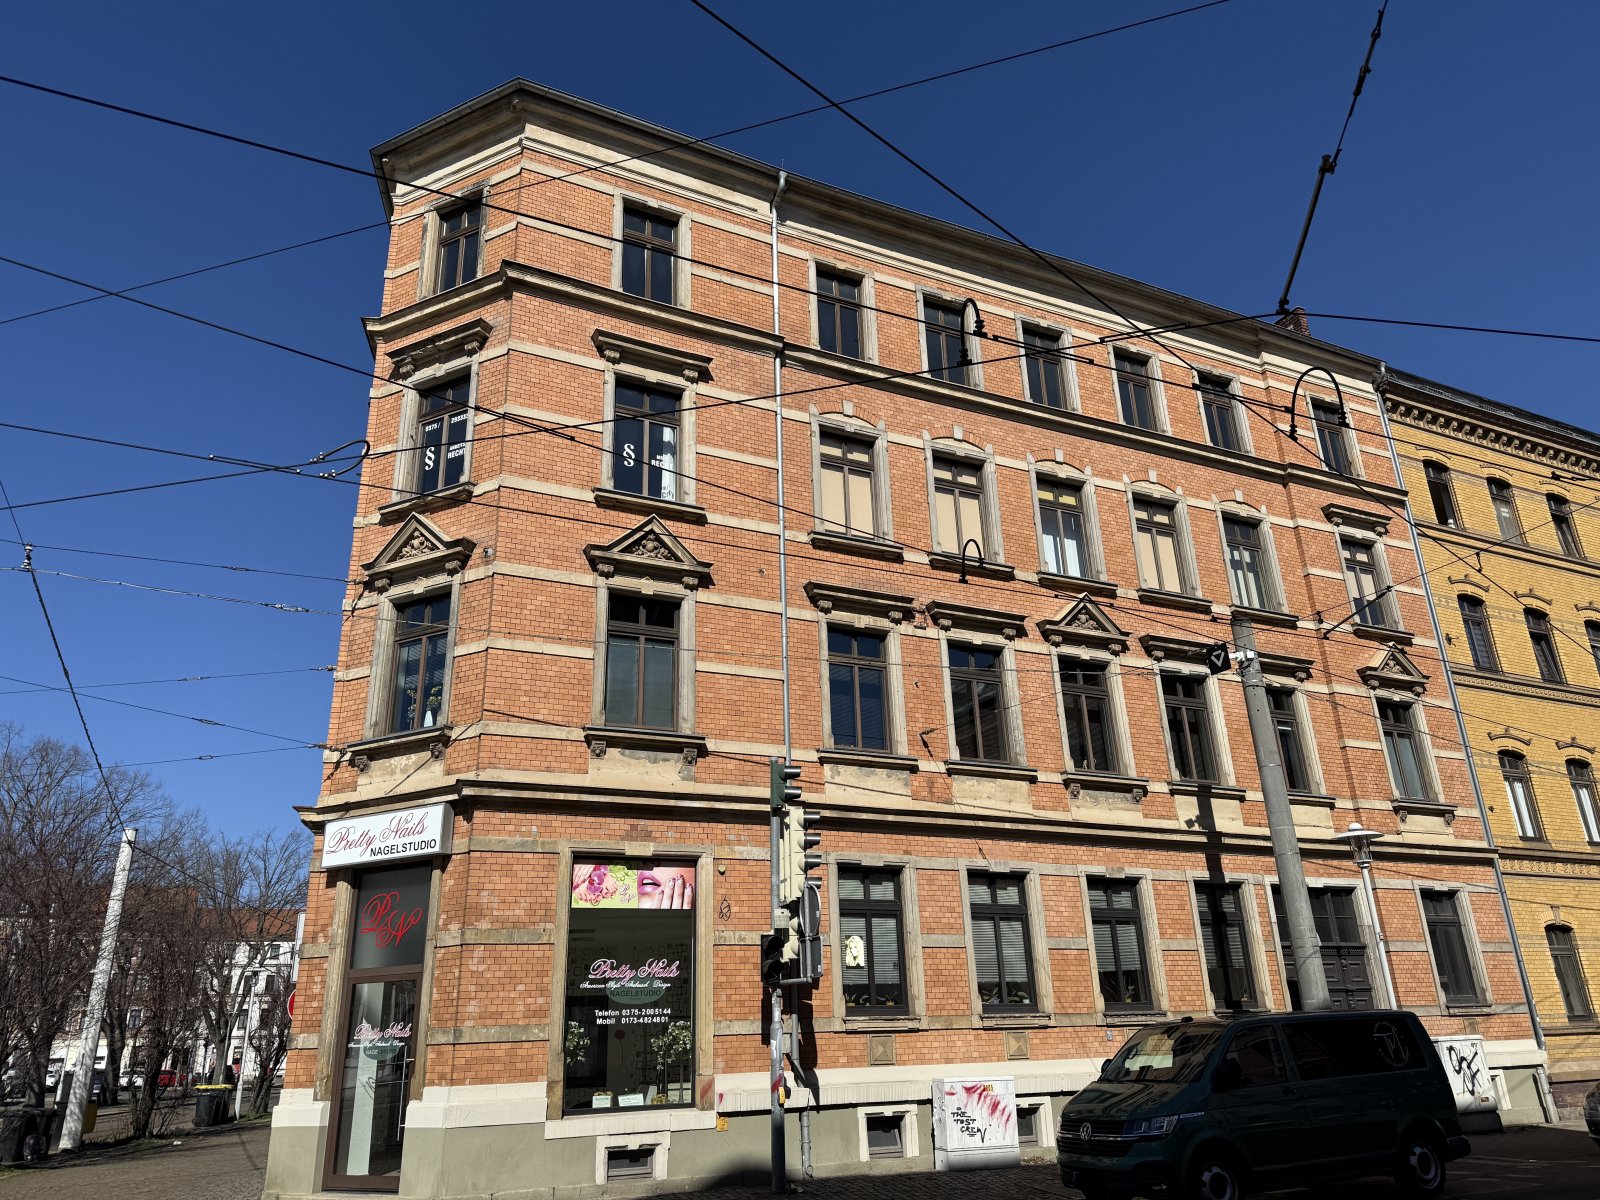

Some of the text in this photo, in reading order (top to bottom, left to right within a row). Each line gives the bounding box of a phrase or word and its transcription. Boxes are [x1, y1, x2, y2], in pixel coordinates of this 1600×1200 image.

[326, 811, 429, 857] Pretty Nails
[370, 838, 437, 858] NAGELSTUDIO
[588, 958, 680, 985] Pretty Nails
[609, 989, 661, 998] NAGELSTUDIO
